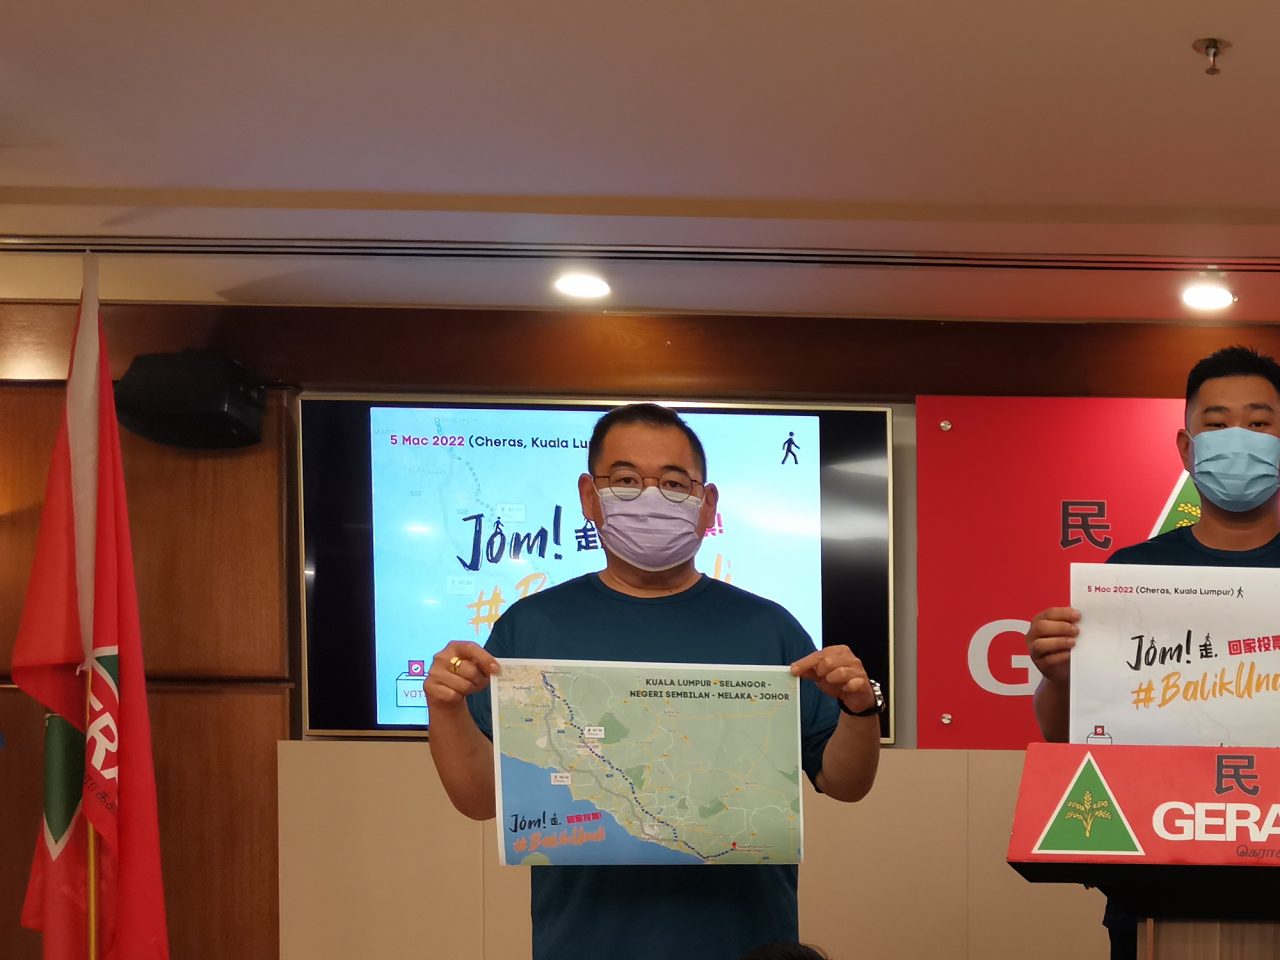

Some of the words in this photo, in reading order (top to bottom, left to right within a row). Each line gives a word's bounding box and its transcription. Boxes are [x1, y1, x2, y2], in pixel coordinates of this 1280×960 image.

[390, 434, 398, 445] 5
[402, 435, 428, 446] Mac
[432, 436, 465, 446] 2022
[469, 436, 527, 449] (Cheras,
[531, 437, 569, 448] Kuala
[1059, 500, 1113, 550] 民
[456, 504, 563, 571] Jom!
[1135, 586, 1172, 595] (Cheras,
[1199, 588, 1234, 596] Lumpur)
[1126, 630, 1192, 671] Jom!
[645, 678, 676, 687] KUALA
[678, 679, 711, 687] LUMPUR
[719, 680, 766, 688] SELANGOR
[403, 689, 426, 699] VOT
[630, 690, 663, 698] NEGERI
[666, 691, 710, 699] SEMBILAN
[718, 692, 752, 700] MELAKA
[760, 693, 790, 701] JOHOR
[509, 811, 546, 833] Jom!
